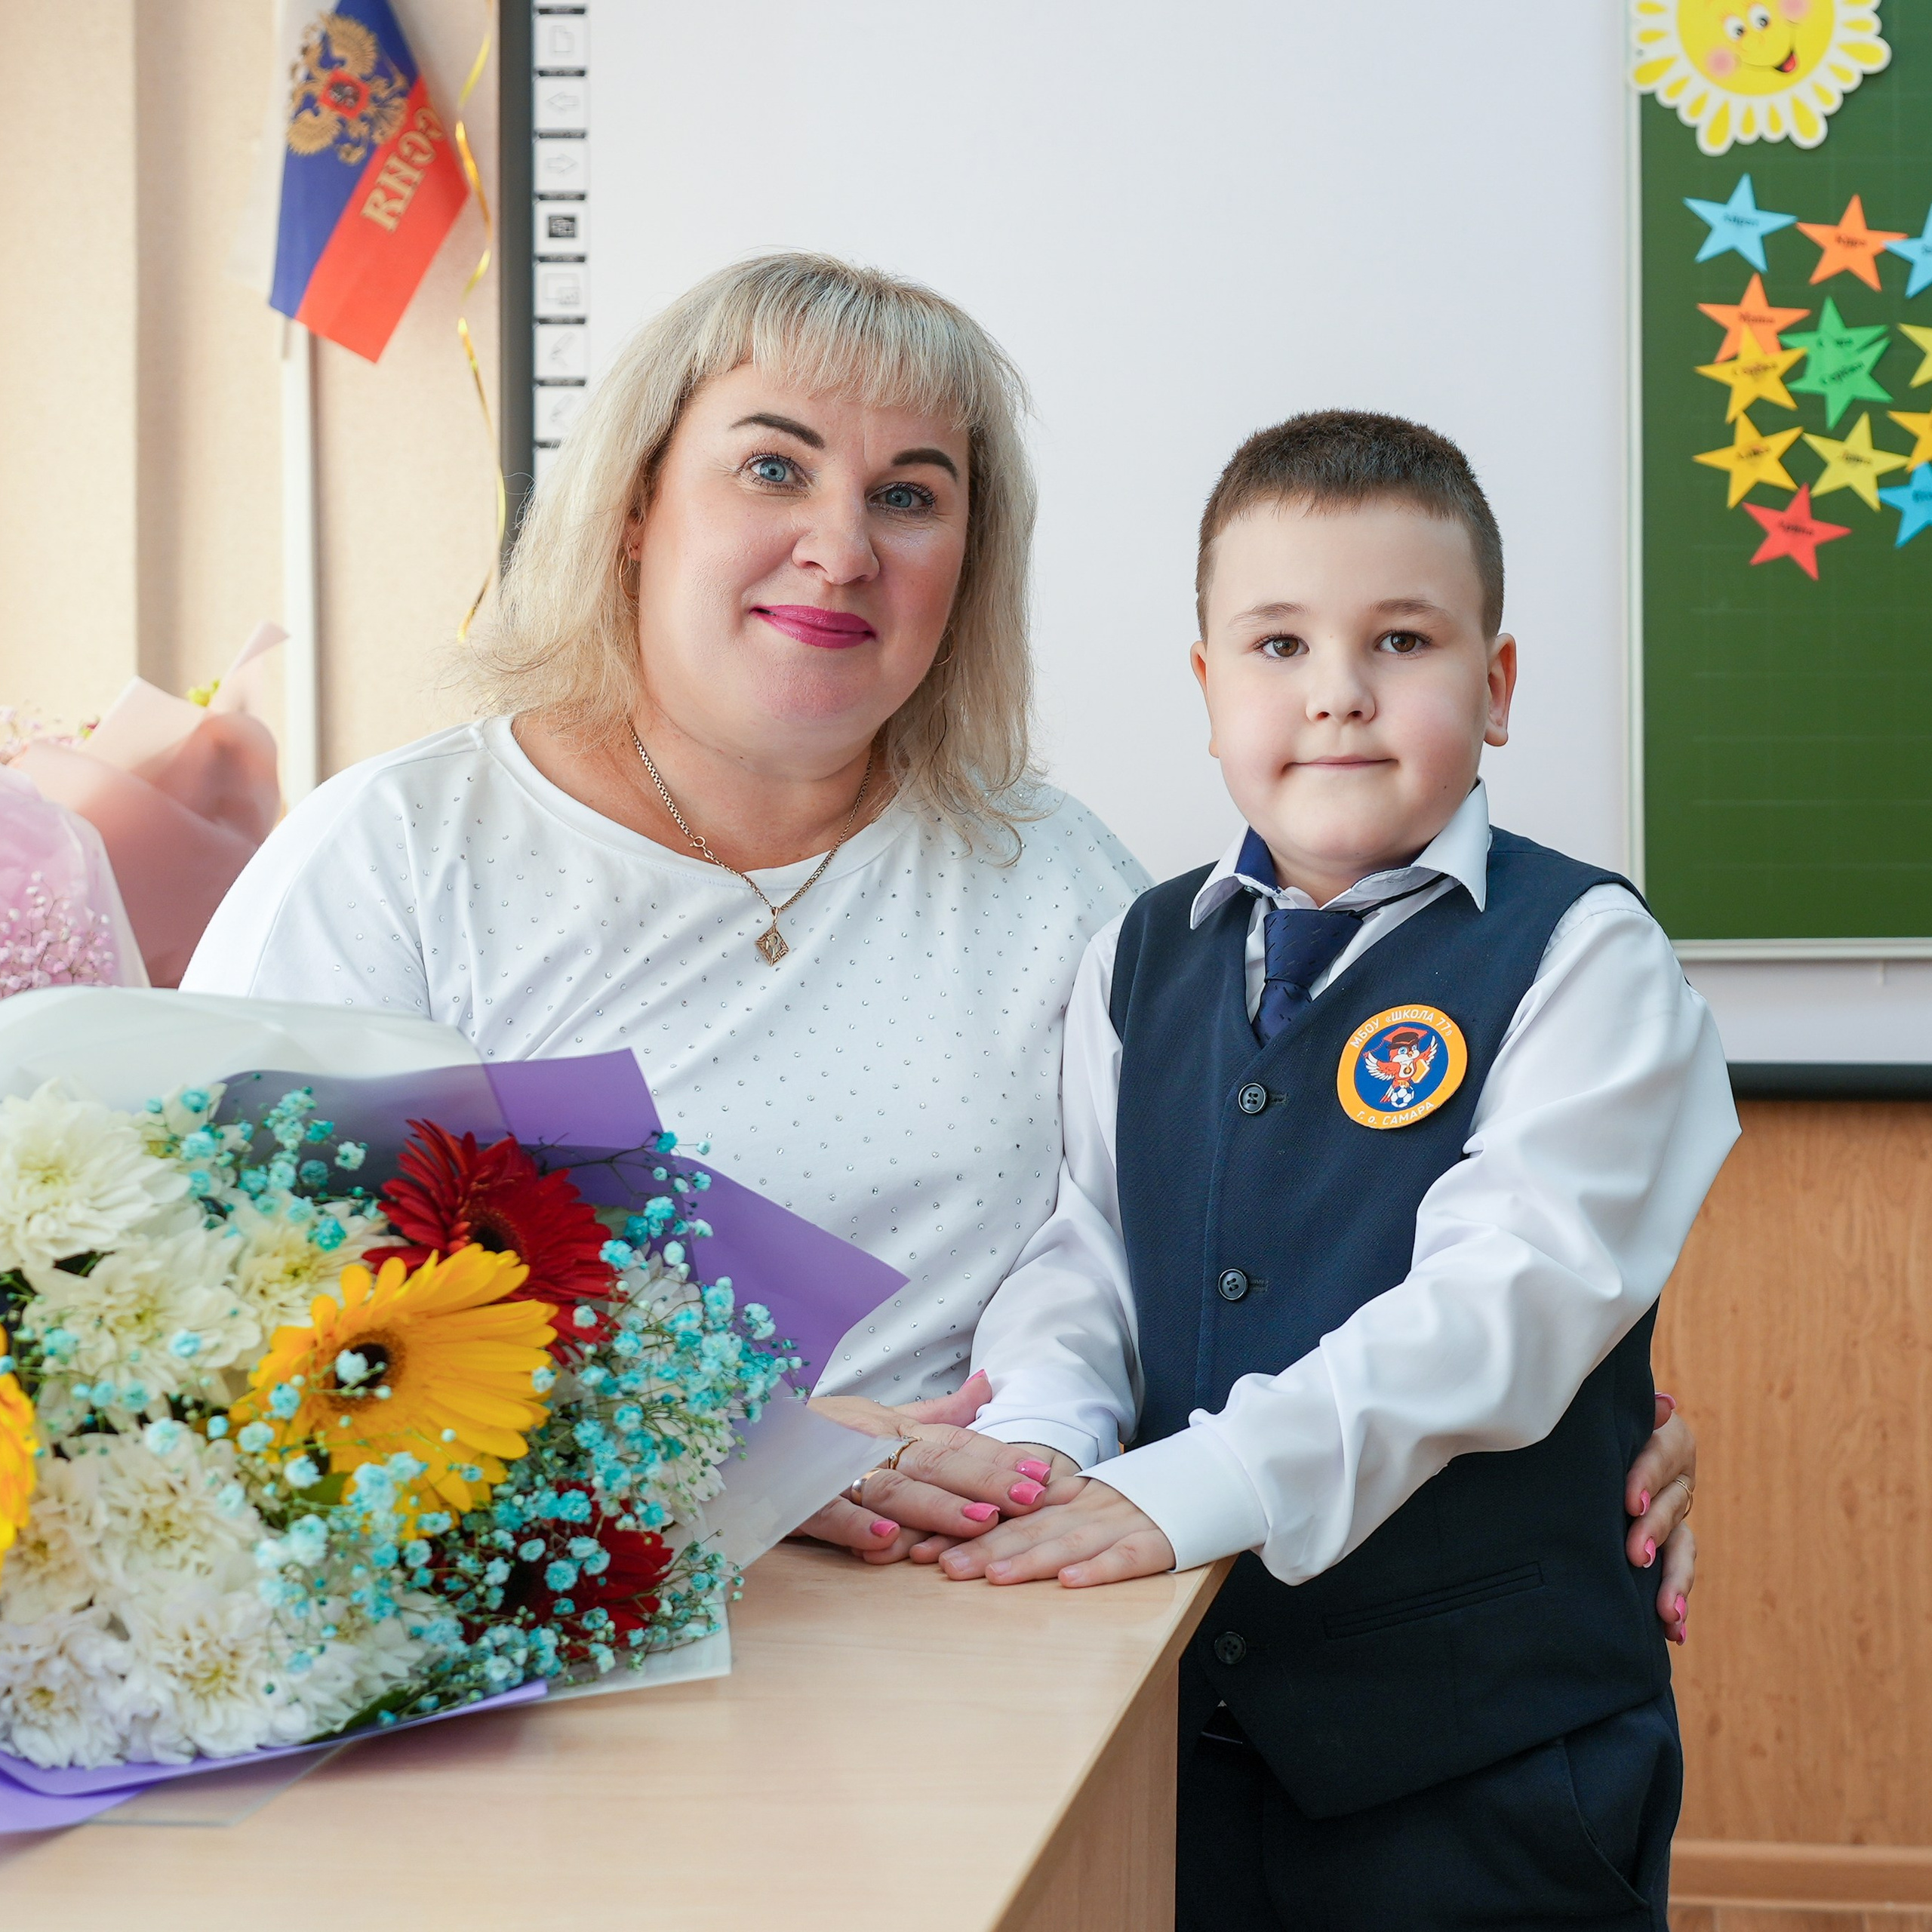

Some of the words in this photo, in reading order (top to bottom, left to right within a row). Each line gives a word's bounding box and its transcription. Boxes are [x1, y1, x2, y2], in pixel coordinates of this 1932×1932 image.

[1349, 1018, 1380, 1048] МБОУ
[1386, 1008, 1435, 1023] «ШКОЛА
[1436, 1017, 1454, 1036] 77»
[1383, 1101, 1435, 1125] САМАРА
